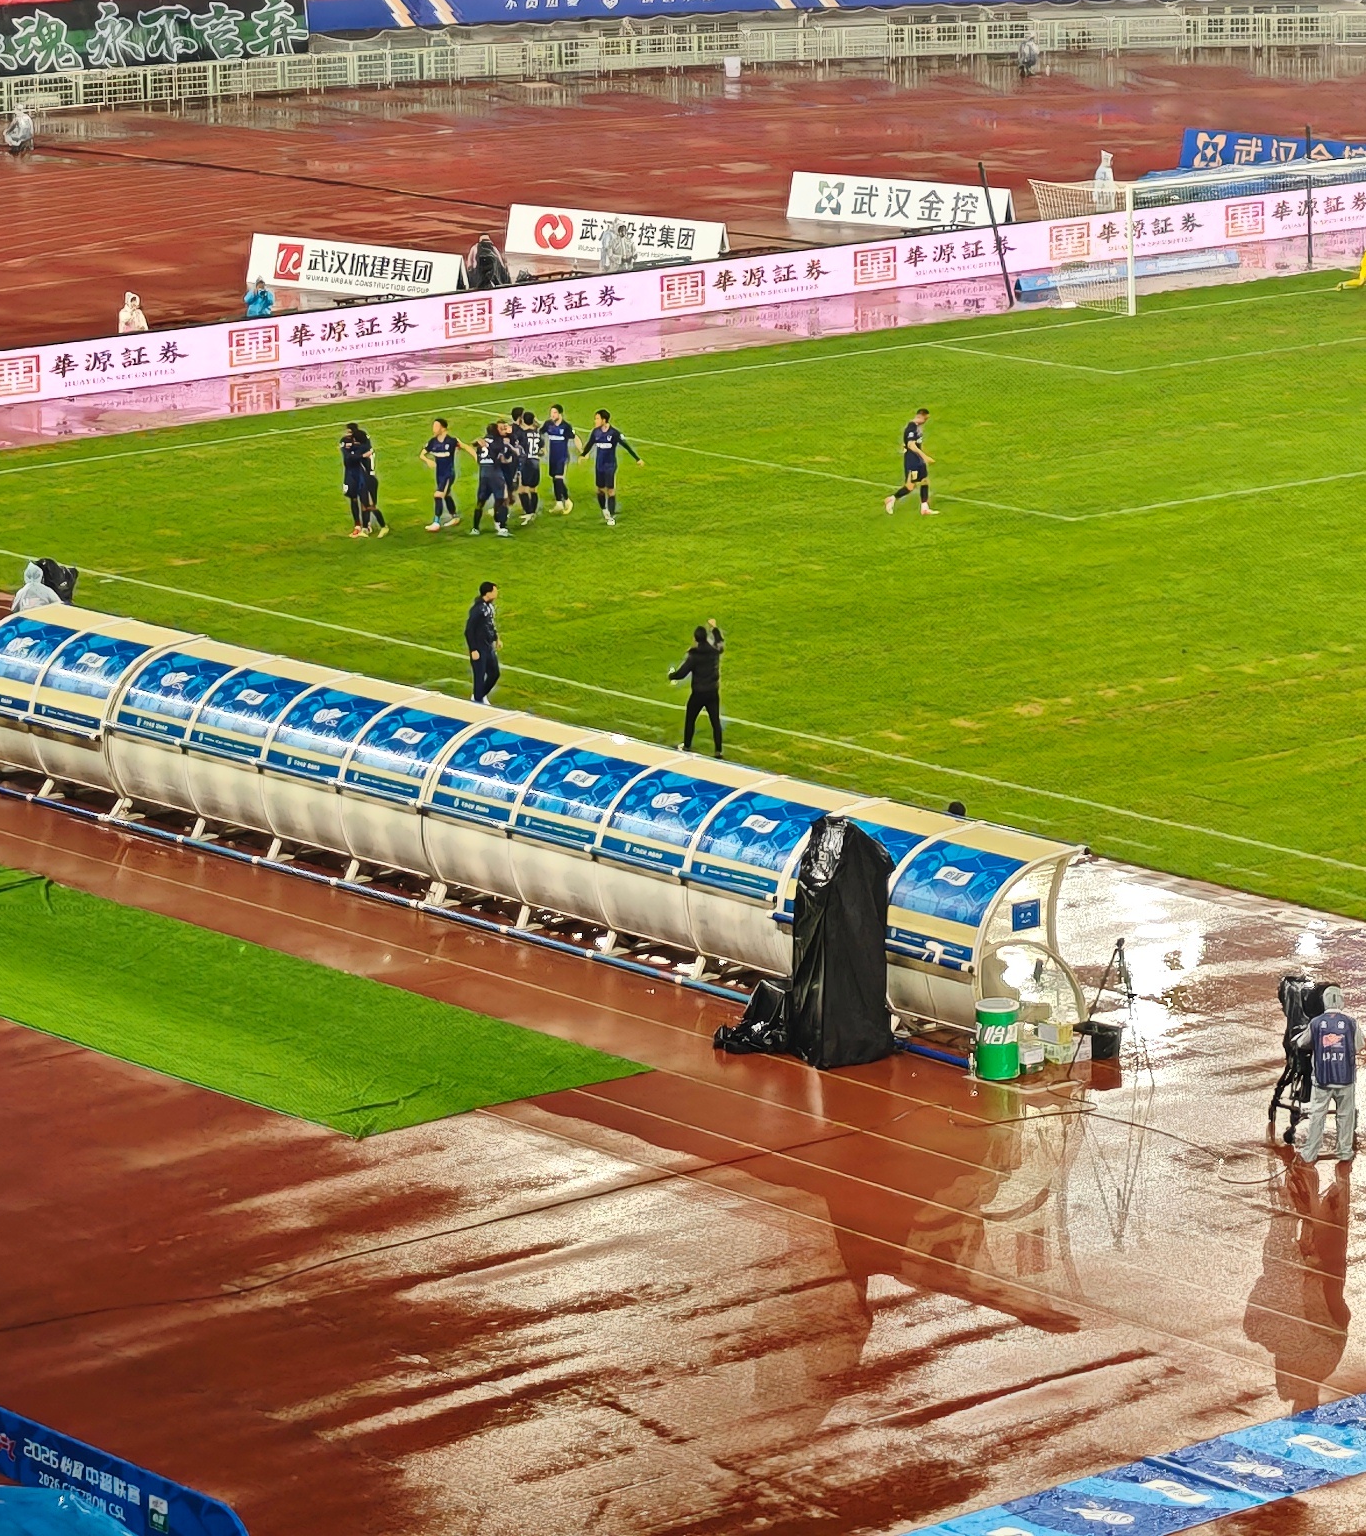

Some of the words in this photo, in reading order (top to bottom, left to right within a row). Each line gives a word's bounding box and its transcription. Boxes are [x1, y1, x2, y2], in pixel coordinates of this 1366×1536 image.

[851, 184, 979, 224] 武汉金控
[307, 248, 433, 284] 武汉城建集团
[903, 235, 1017, 268] 華源証券
[712, 259, 831, 293] 華源証券
[499, 285, 625, 320] 華源証券
[287, 311, 419, 347] 華源証券
[49, 340, 189, 378] 華源証券
[23, 1438, 59, 1470] 2026
[108, 1502, 126, 1522] CSL
